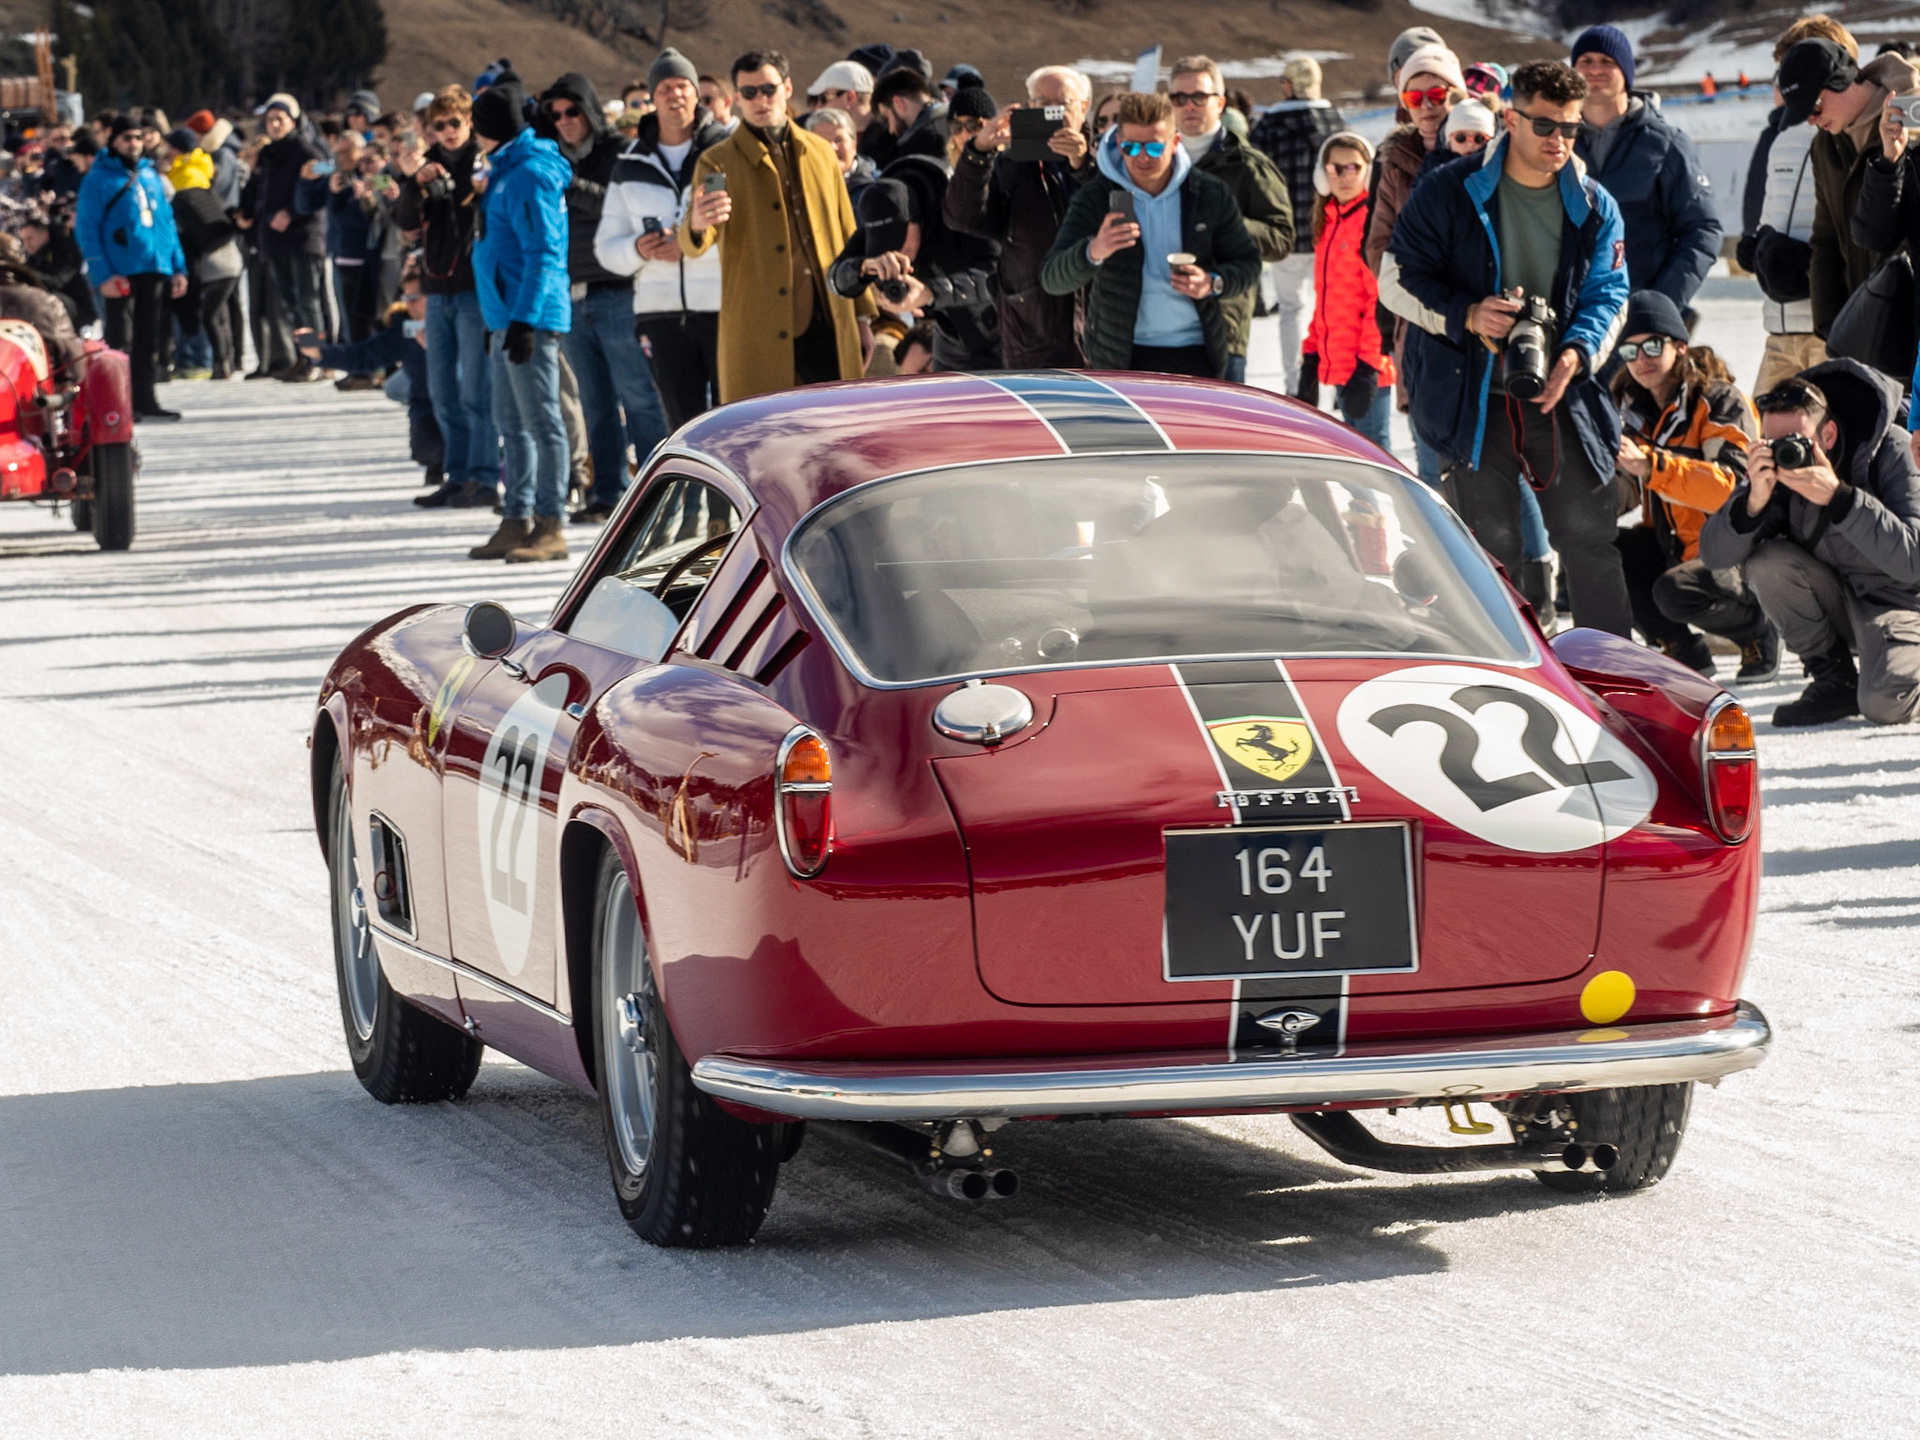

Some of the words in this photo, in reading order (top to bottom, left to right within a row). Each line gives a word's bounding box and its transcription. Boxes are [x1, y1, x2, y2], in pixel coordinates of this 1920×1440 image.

[1367, 684, 1634, 812] 22
[493, 725, 538, 916] 22
[1235, 846, 1333, 896] 164
[1231, 911, 1346, 960] YUF
